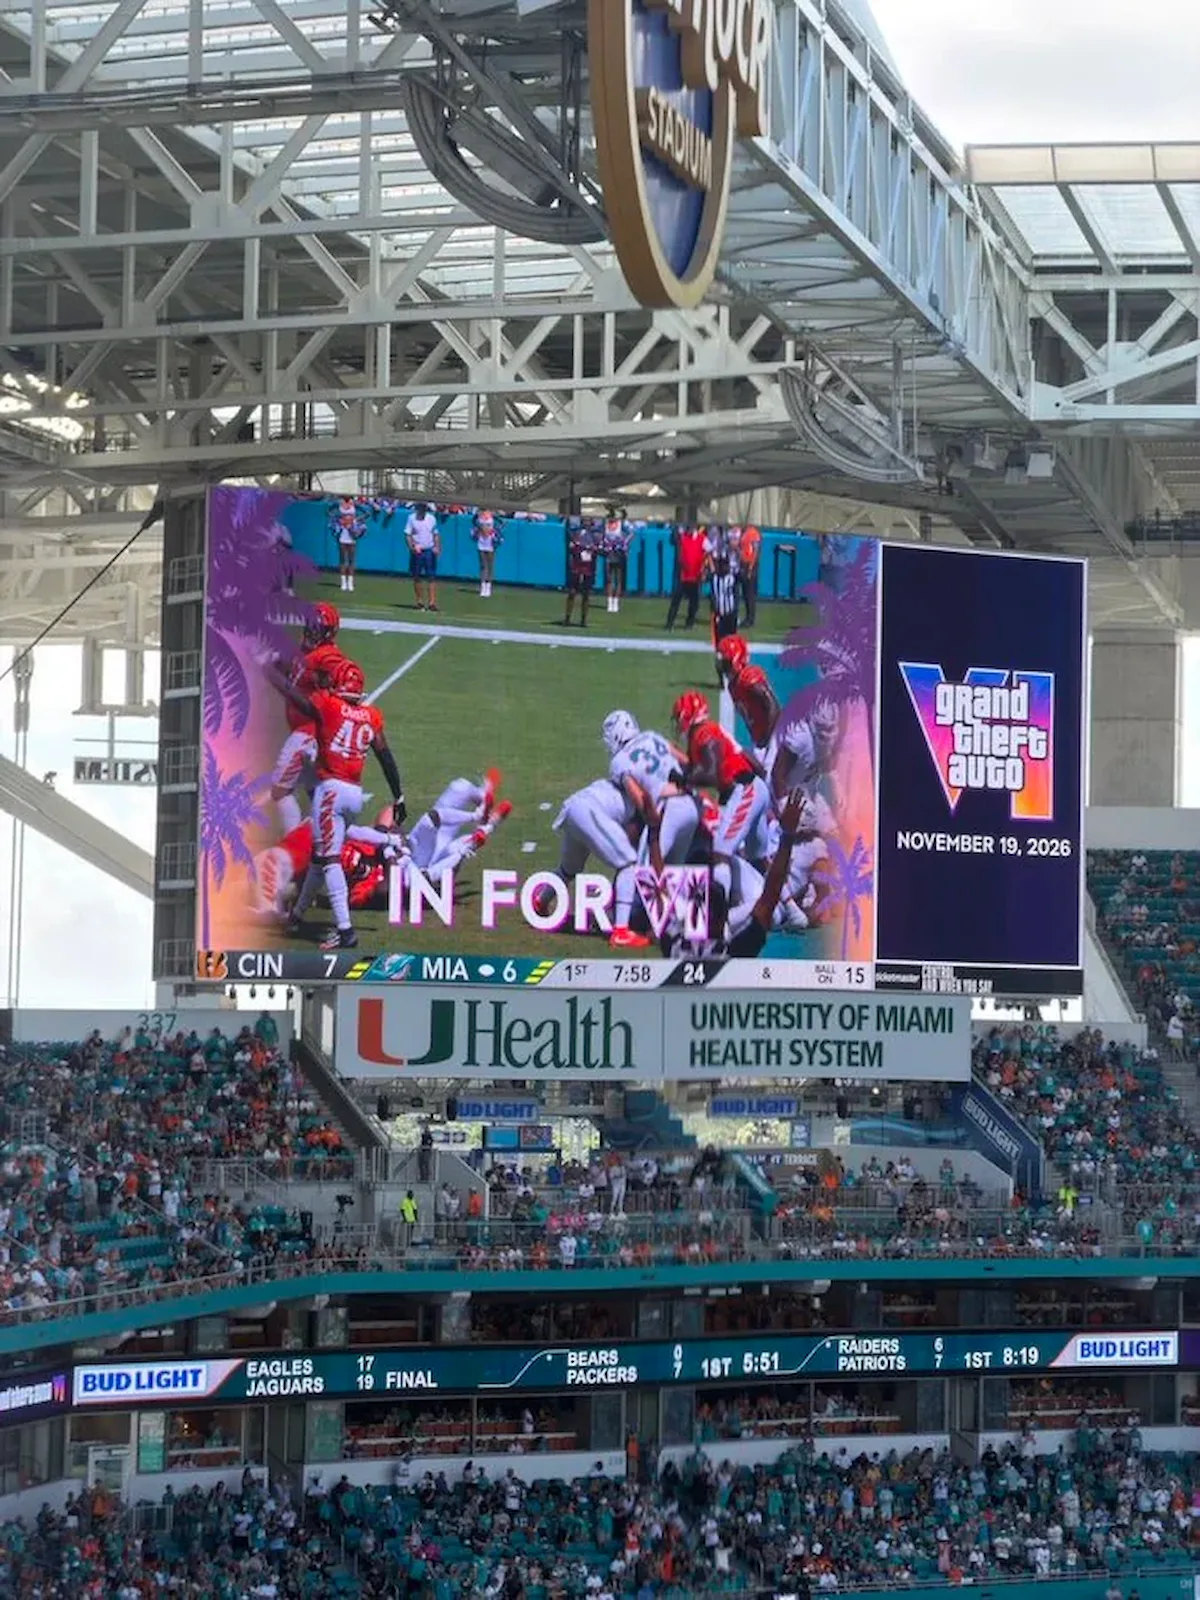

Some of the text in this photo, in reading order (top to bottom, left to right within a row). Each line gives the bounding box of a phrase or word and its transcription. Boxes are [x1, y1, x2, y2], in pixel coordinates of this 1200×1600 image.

[647, 85, 712, 192] STADIUM
[953, 720, 1047, 760] theft
[949, 754, 1024, 791] auto
[897, 831, 1072, 858] NOVEMBER 19, 2026
[388, 865, 454, 928] IN
[481, 869, 613, 933] FOR
[238, 953, 338, 978] CIN 7
[422, 956, 517, 982] MIA 6
[565, 964, 651, 983] 1ST 7:58
[683, 962, 705, 984] 24
[762, 966, 771, 980] &
[814, 964, 836, 974] BALL
[845, 967, 865, 984] 15
[817, 973, 833, 985] ON
[138, 1012, 177, 1034] 337
[690, 1002, 954, 1034] UNIVERSITY OF MIAMI
[689, 1039, 883, 1068] HEALTH SYSTEM
[485, 1102, 536, 1119] LIGHT
[711, 1099, 746, 1114] BUD
[964, 1098, 1020, 1159] BUD LIGHT
[838, 1337, 943, 1355] RAIDERS 6
[964, 1346, 1040, 1368] 1ST 8:19
[1080, 1339, 1171, 1360] BUD LIGHT
[246, 1355, 375, 1378] EAGLES 17
[567, 1350, 619, 1367] BEARS
[701, 1352, 780, 1379] 1ST 5:51
[838, 1354, 943, 1372] PATRIOTS 7
[82, 1368, 203, 1393] BUD LIGHT
[245, 1371, 437, 1397] JAGUARS 19 FINAL
[566, 1361, 683, 1385] PACKERS 7
